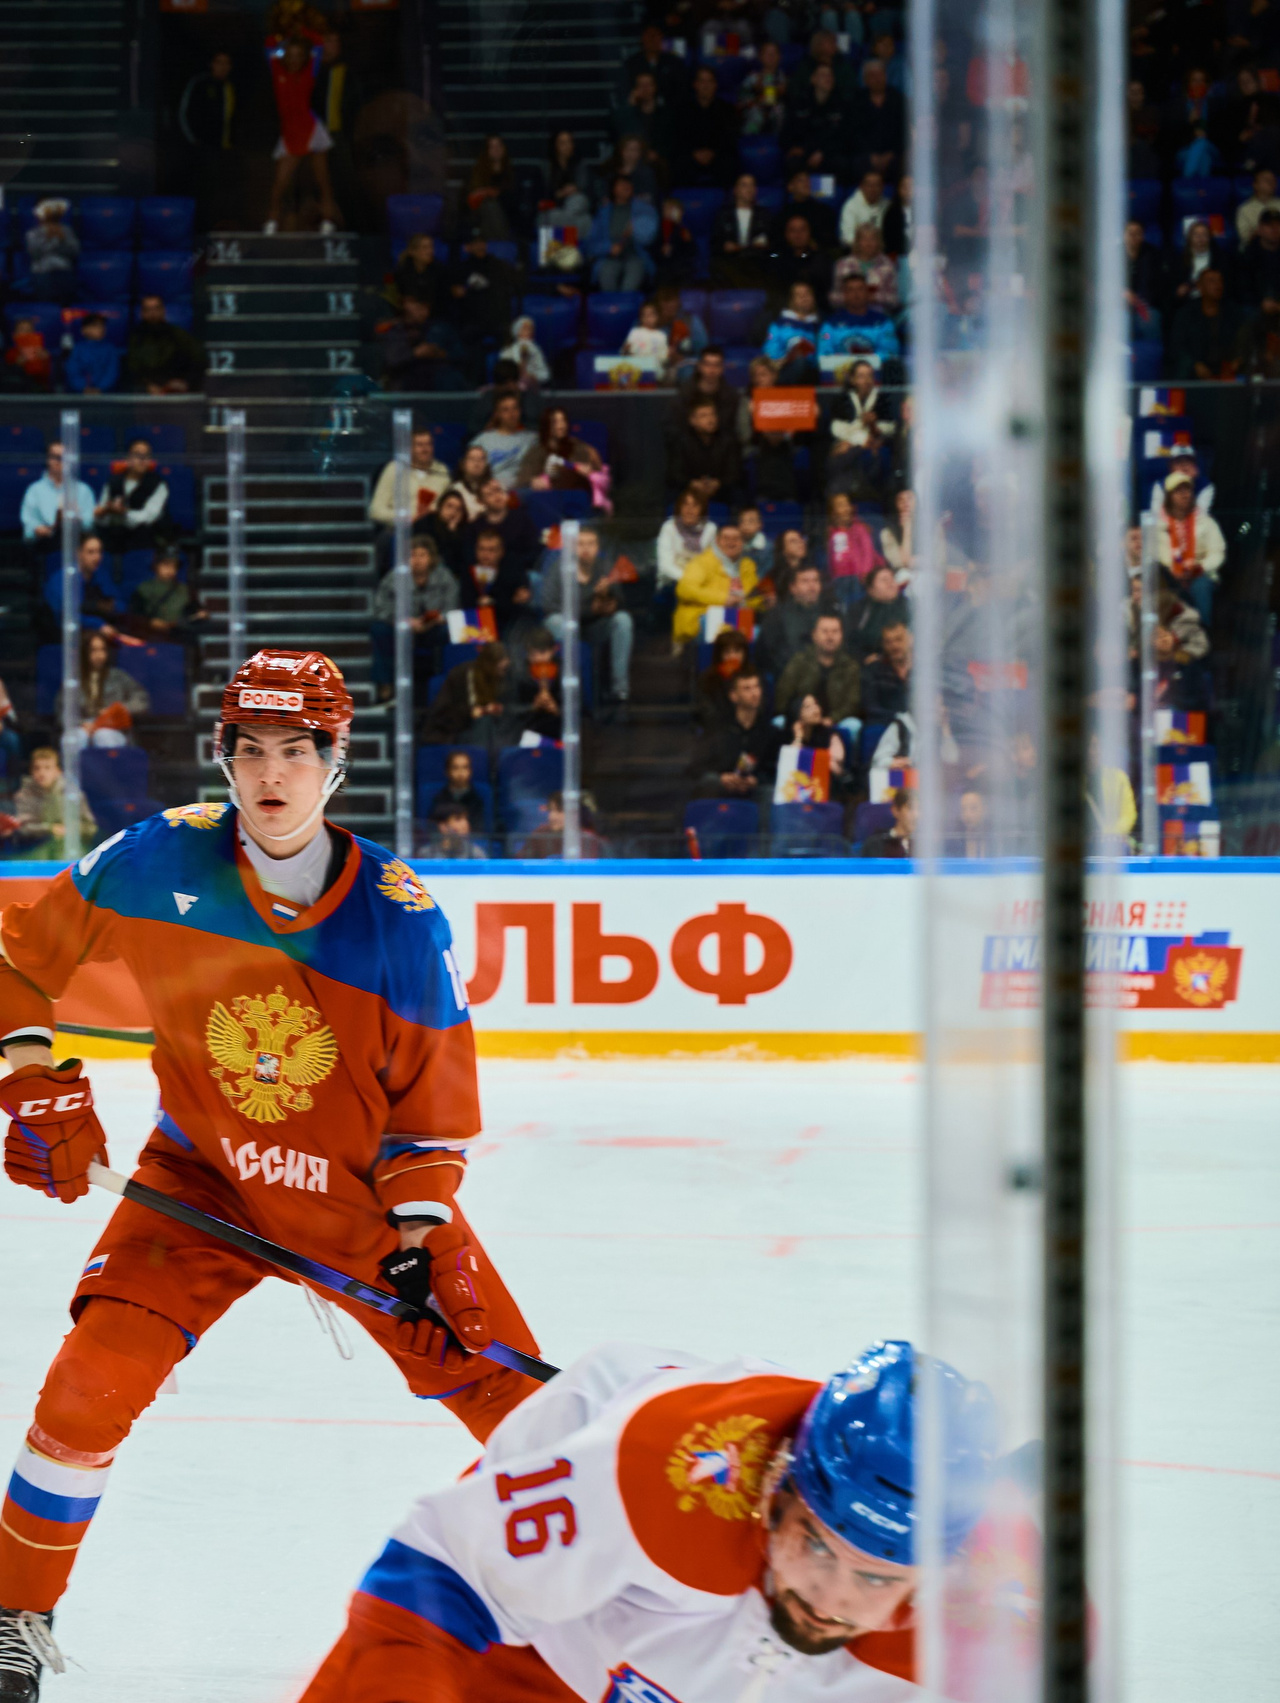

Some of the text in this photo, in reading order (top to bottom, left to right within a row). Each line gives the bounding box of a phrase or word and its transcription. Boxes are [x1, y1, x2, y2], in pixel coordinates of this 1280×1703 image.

[217, 241, 241, 263] 14
[324, 237, 350, 263] 14
[210, 292, 237, 315] 13
[327, 291, 354, 315] 13
[209, 350, 236, 372] 12
[327, 349, 355, 372] 12
[242, 692, 300, 708] РОЛЬФ
[465, 901, 794, 1006] ЛЬФ
[495, 1457, 577, 1560] 16
